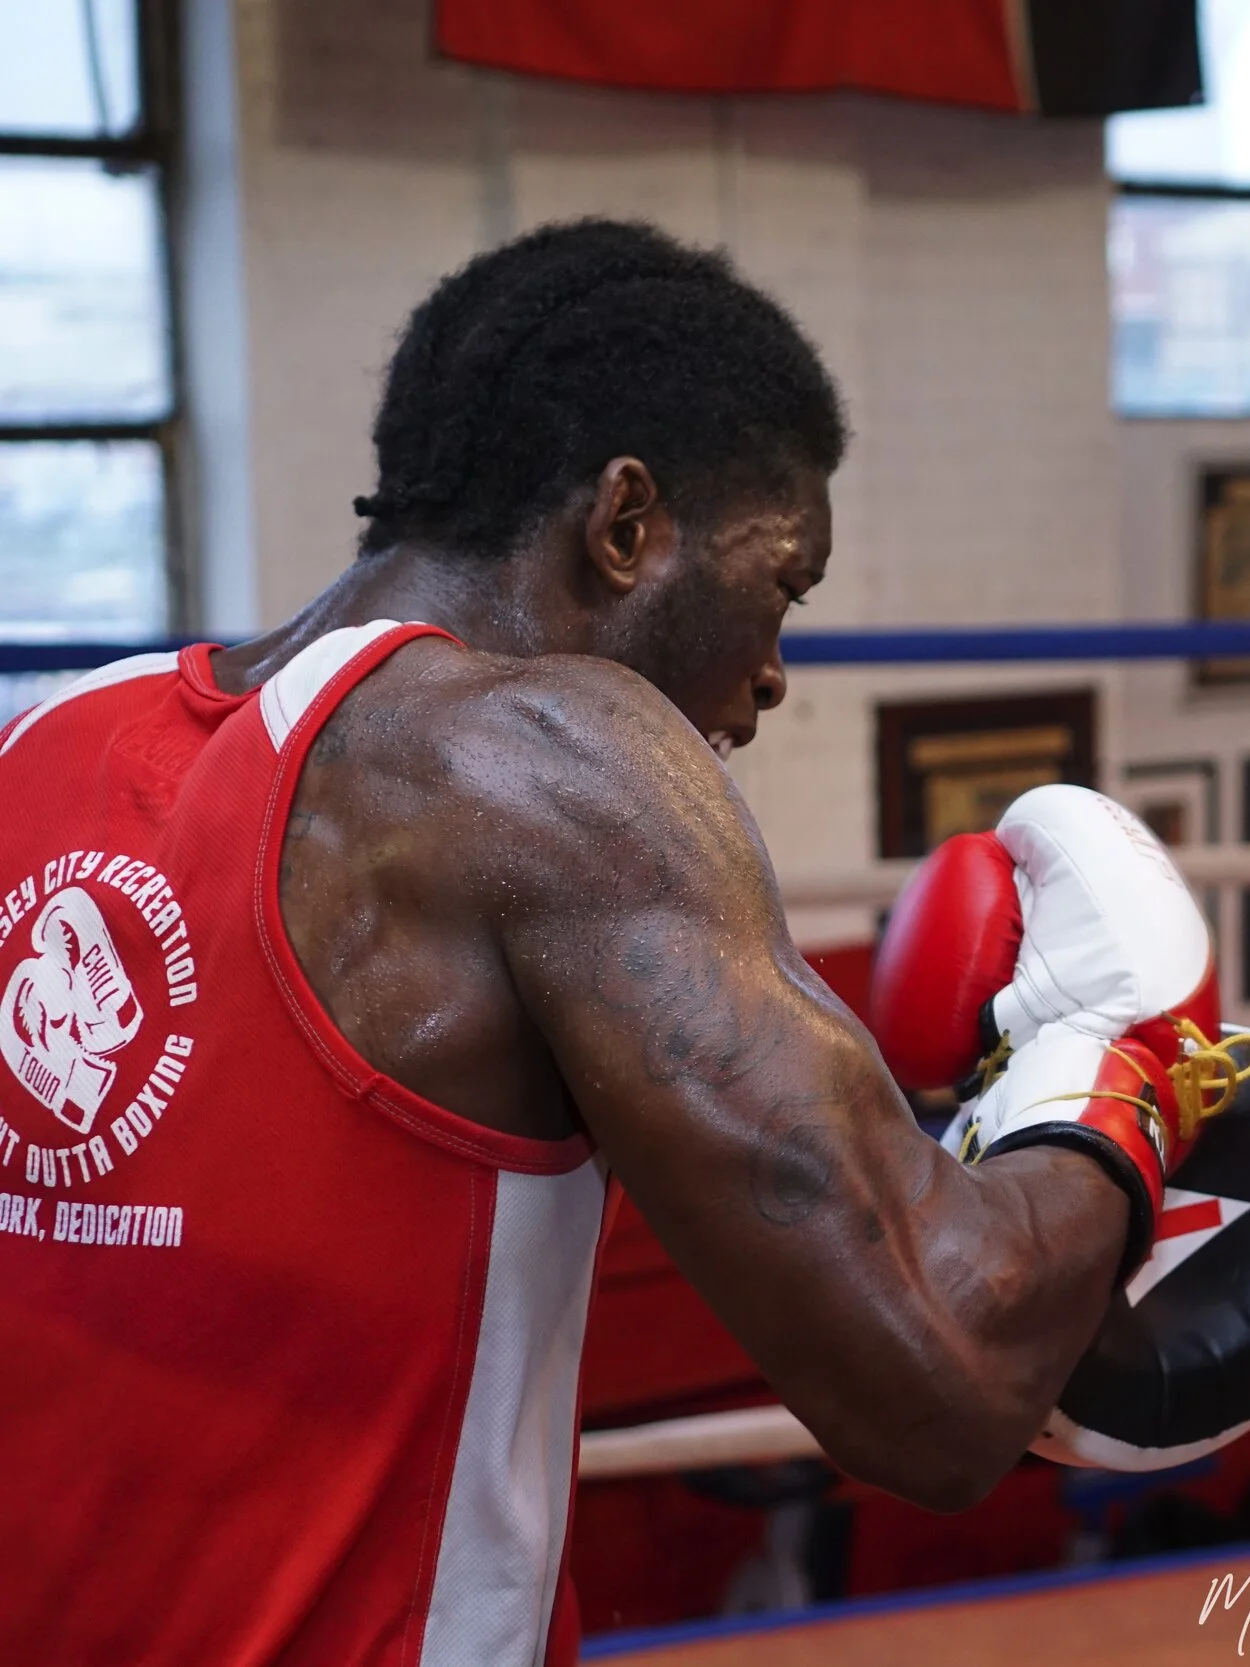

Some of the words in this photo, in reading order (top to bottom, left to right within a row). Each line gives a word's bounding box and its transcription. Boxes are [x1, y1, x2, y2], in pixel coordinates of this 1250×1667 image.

[0, 875, 37, 947] SEY
[44, 850, 104, 895] CITY
[97, 855, 199, 1008] RECREATION
[82, 944, 120, 1012] CHILL
[18, 1047, 61, 1104] TOWN
[26, 1134, 114, 1187] OUTTA
[110, 1034, 194, 1157] BOXING
[53, 1201, 184, 1248] DEDICATION
